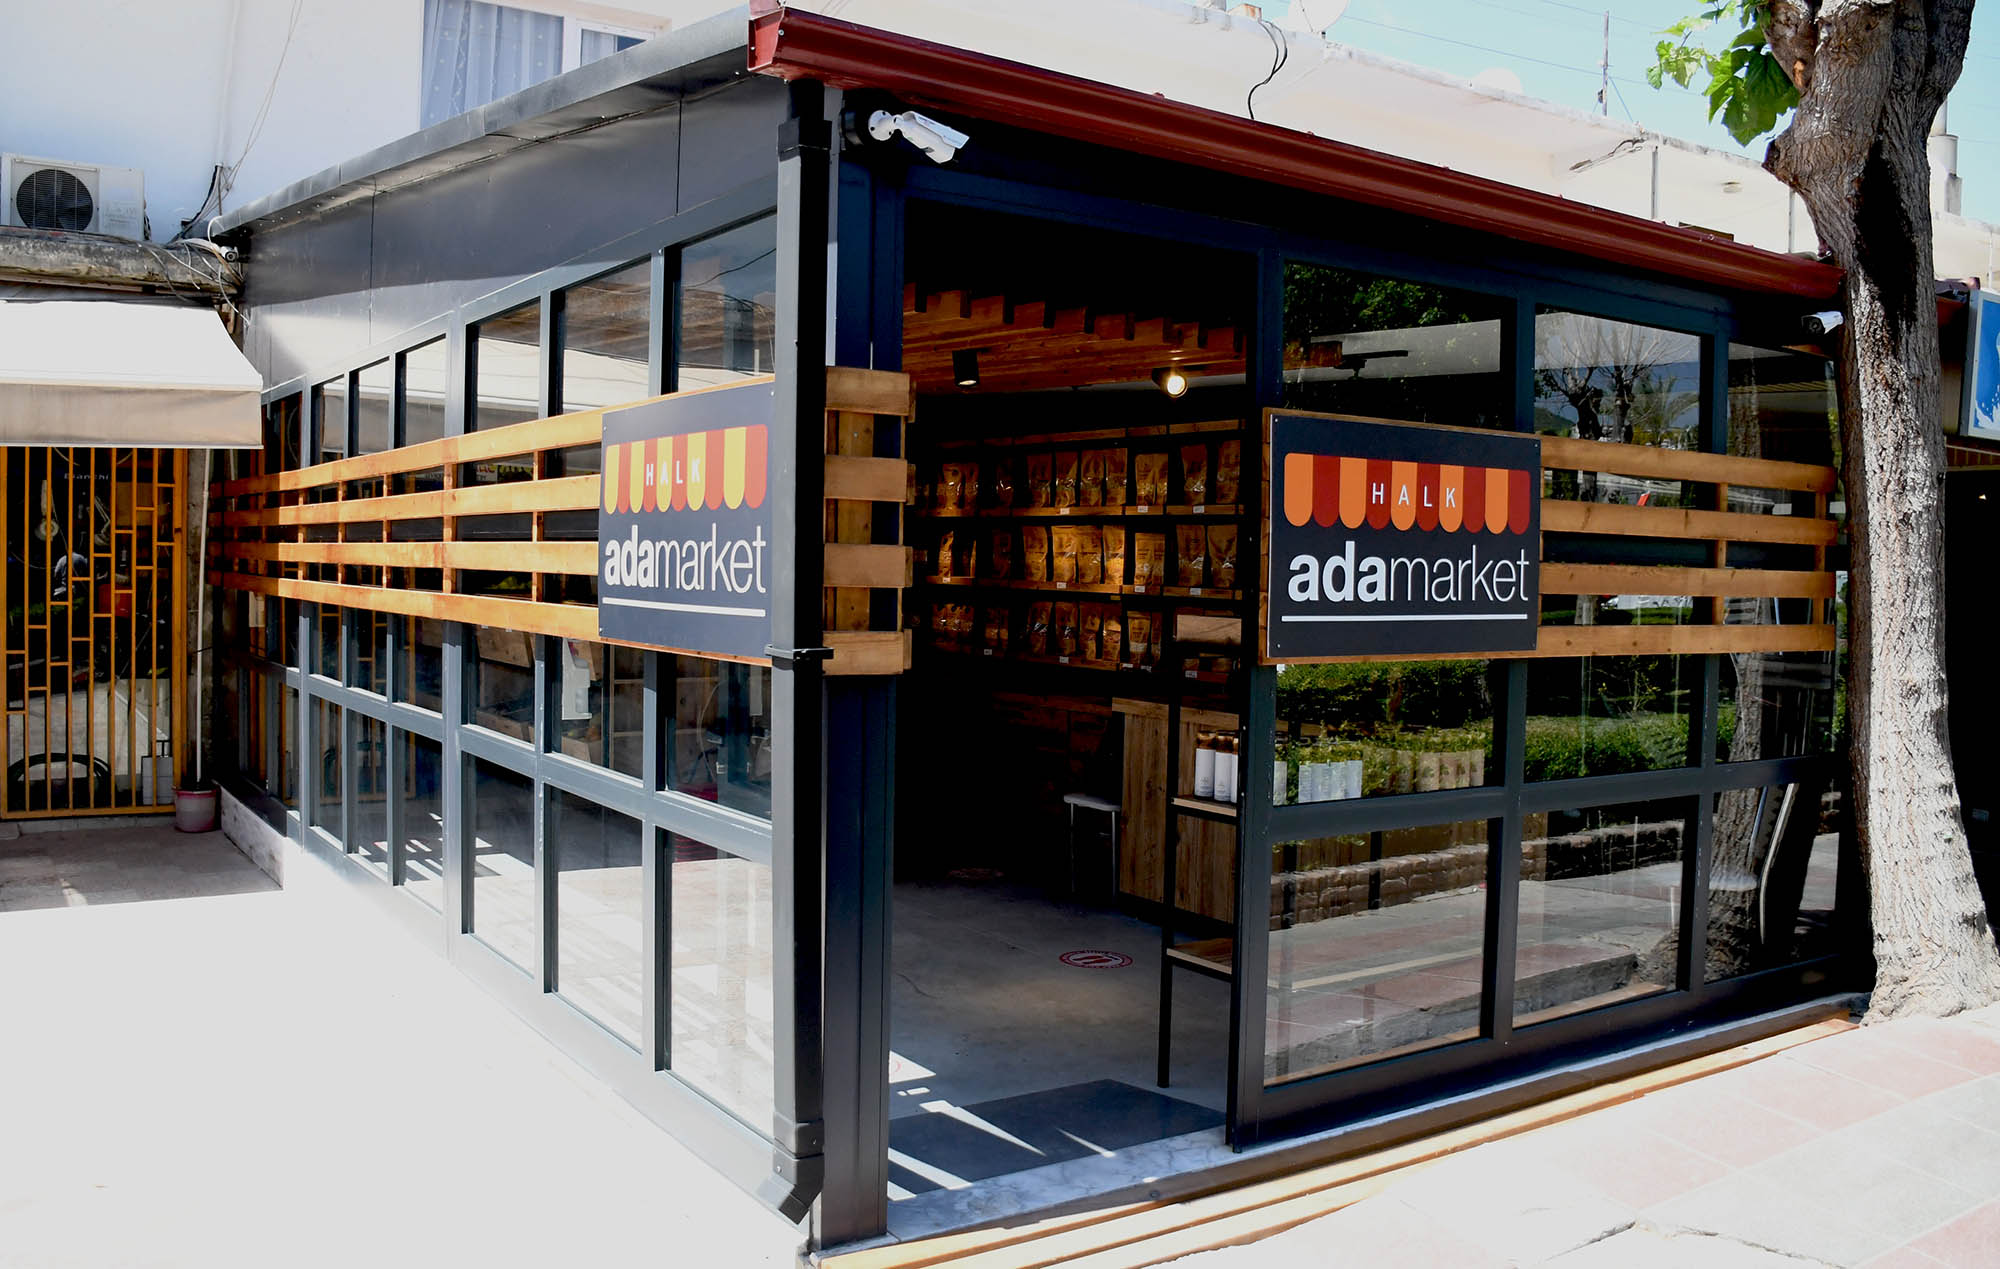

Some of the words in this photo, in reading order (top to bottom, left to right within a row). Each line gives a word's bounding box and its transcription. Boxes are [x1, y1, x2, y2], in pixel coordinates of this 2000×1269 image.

[646, 460, 700, 485] HALK
[1372, 483, 1456, 507] HALK
[605, 523, 766, 593] adamarket
[1288, 541, 1530, 602] adamarket
